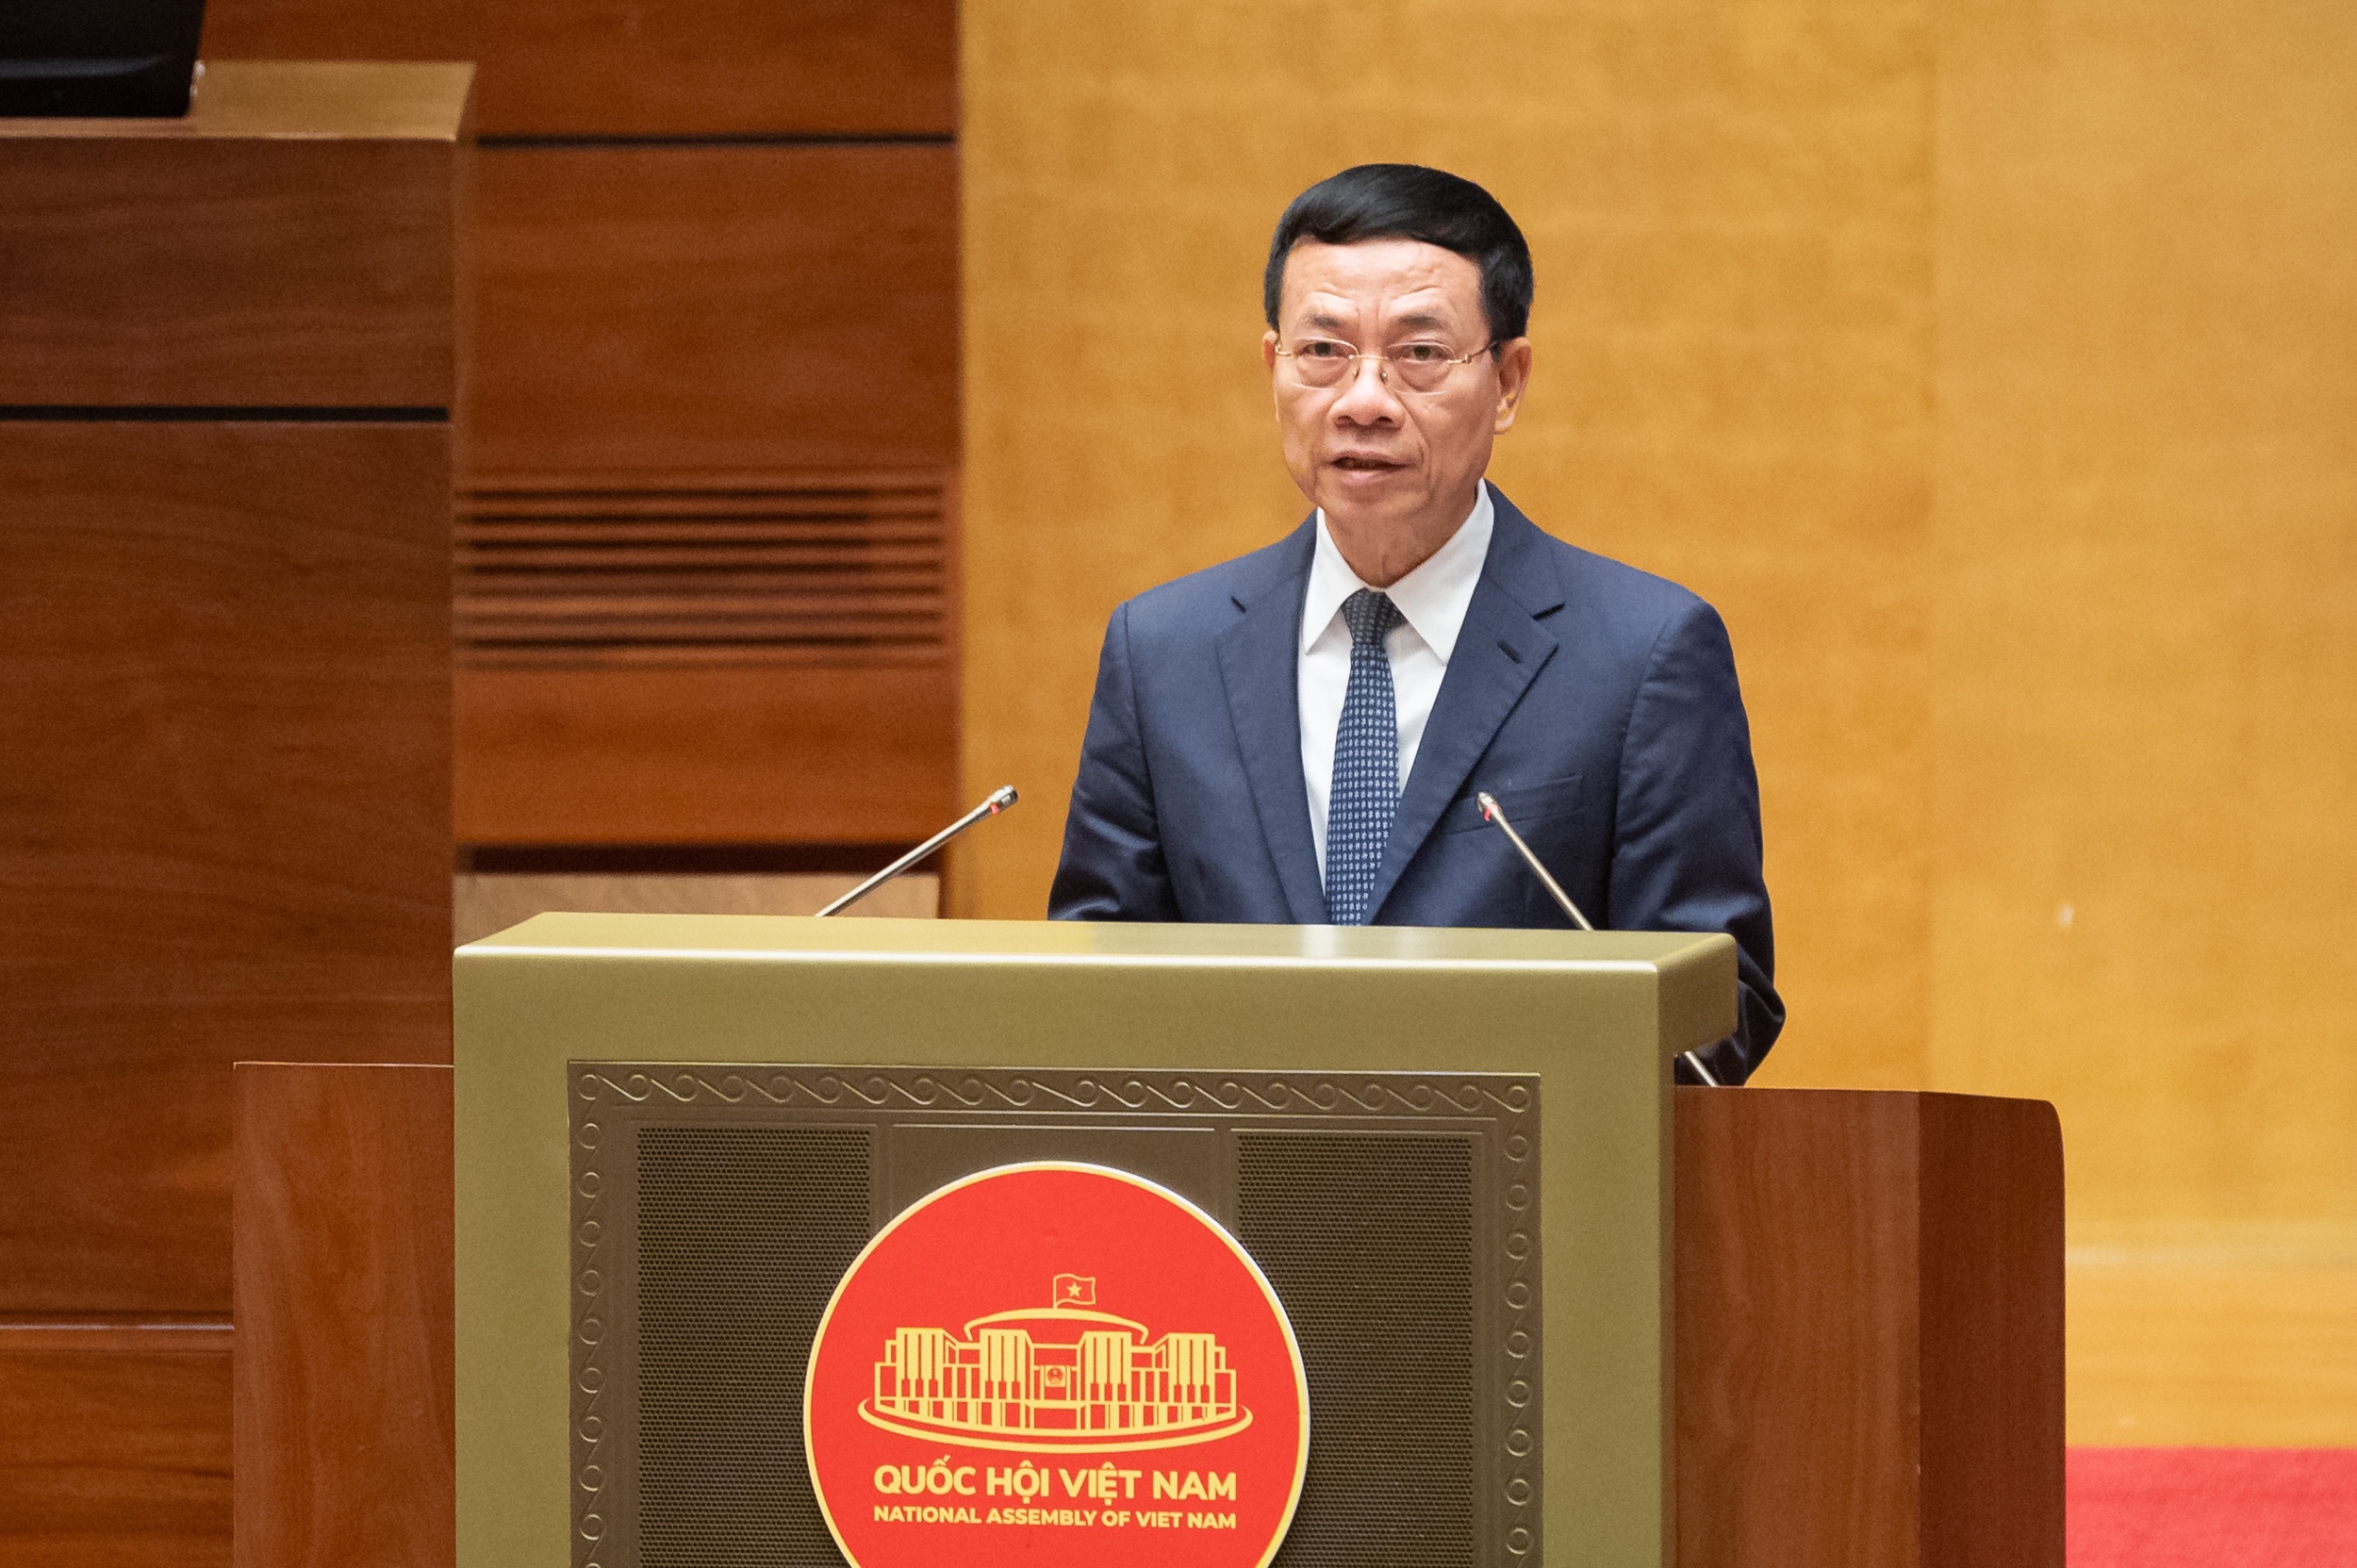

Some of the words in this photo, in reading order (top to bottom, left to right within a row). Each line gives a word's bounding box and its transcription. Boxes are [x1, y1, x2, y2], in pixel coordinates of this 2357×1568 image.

[874, 1454, 976, 1495] QUỐC
[986, 1460, 1049, 1504] HỘI
[1058, 1461, 1142, 1506] VIỆT
[1153, 1470, 1236, 1501] NAM
[874, 1505, 981, 1524] NATIONAL
[986, 1508, 1097, 1526] ASSEMBLY
[1101, 1510, 1130, 1527] OF
[1135, 1510, 1183, 1527] VIET
[1187, 1512, 1236, 1529] NAM
